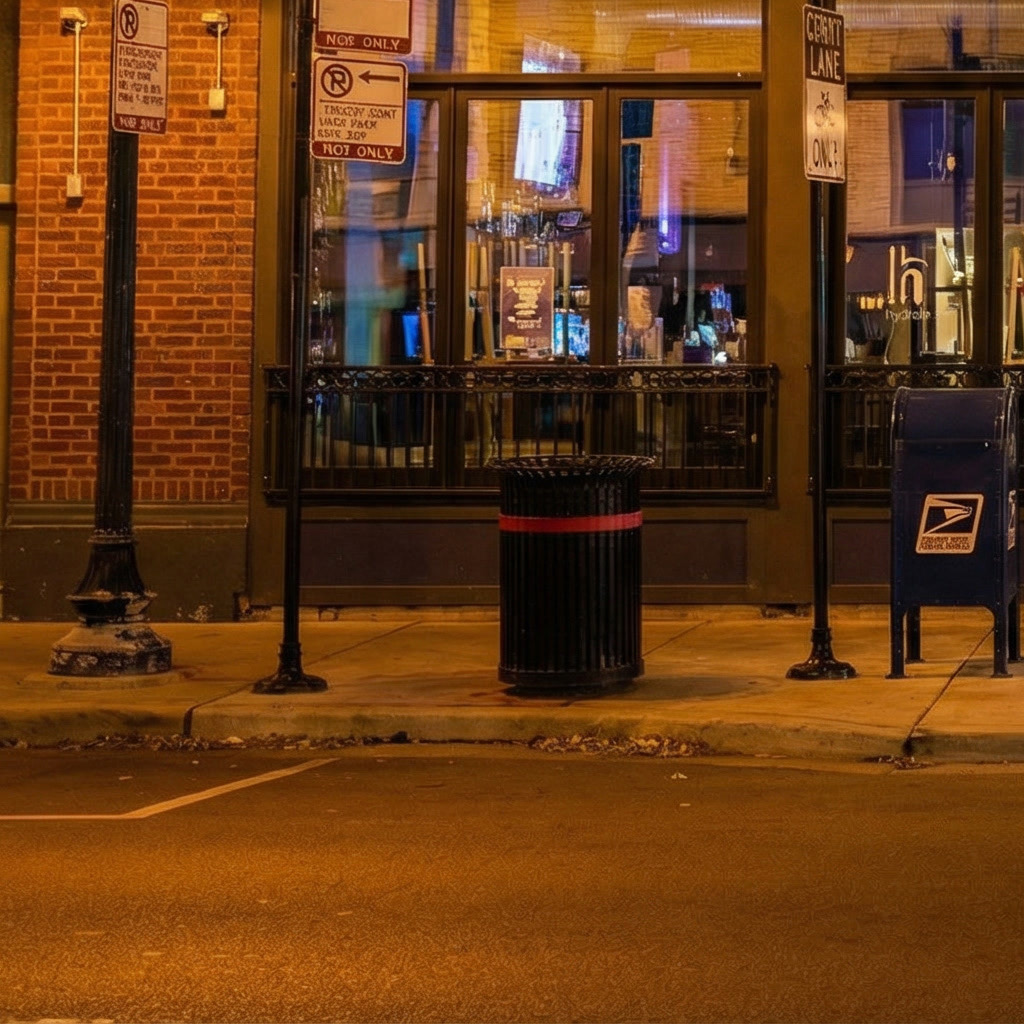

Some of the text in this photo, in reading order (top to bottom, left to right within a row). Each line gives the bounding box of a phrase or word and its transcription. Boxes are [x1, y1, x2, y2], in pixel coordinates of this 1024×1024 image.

[363, 37, 400, 51] ONLY
[810, 45, 842, 81] LANE
[356, 145, 395, 160] ONLY
